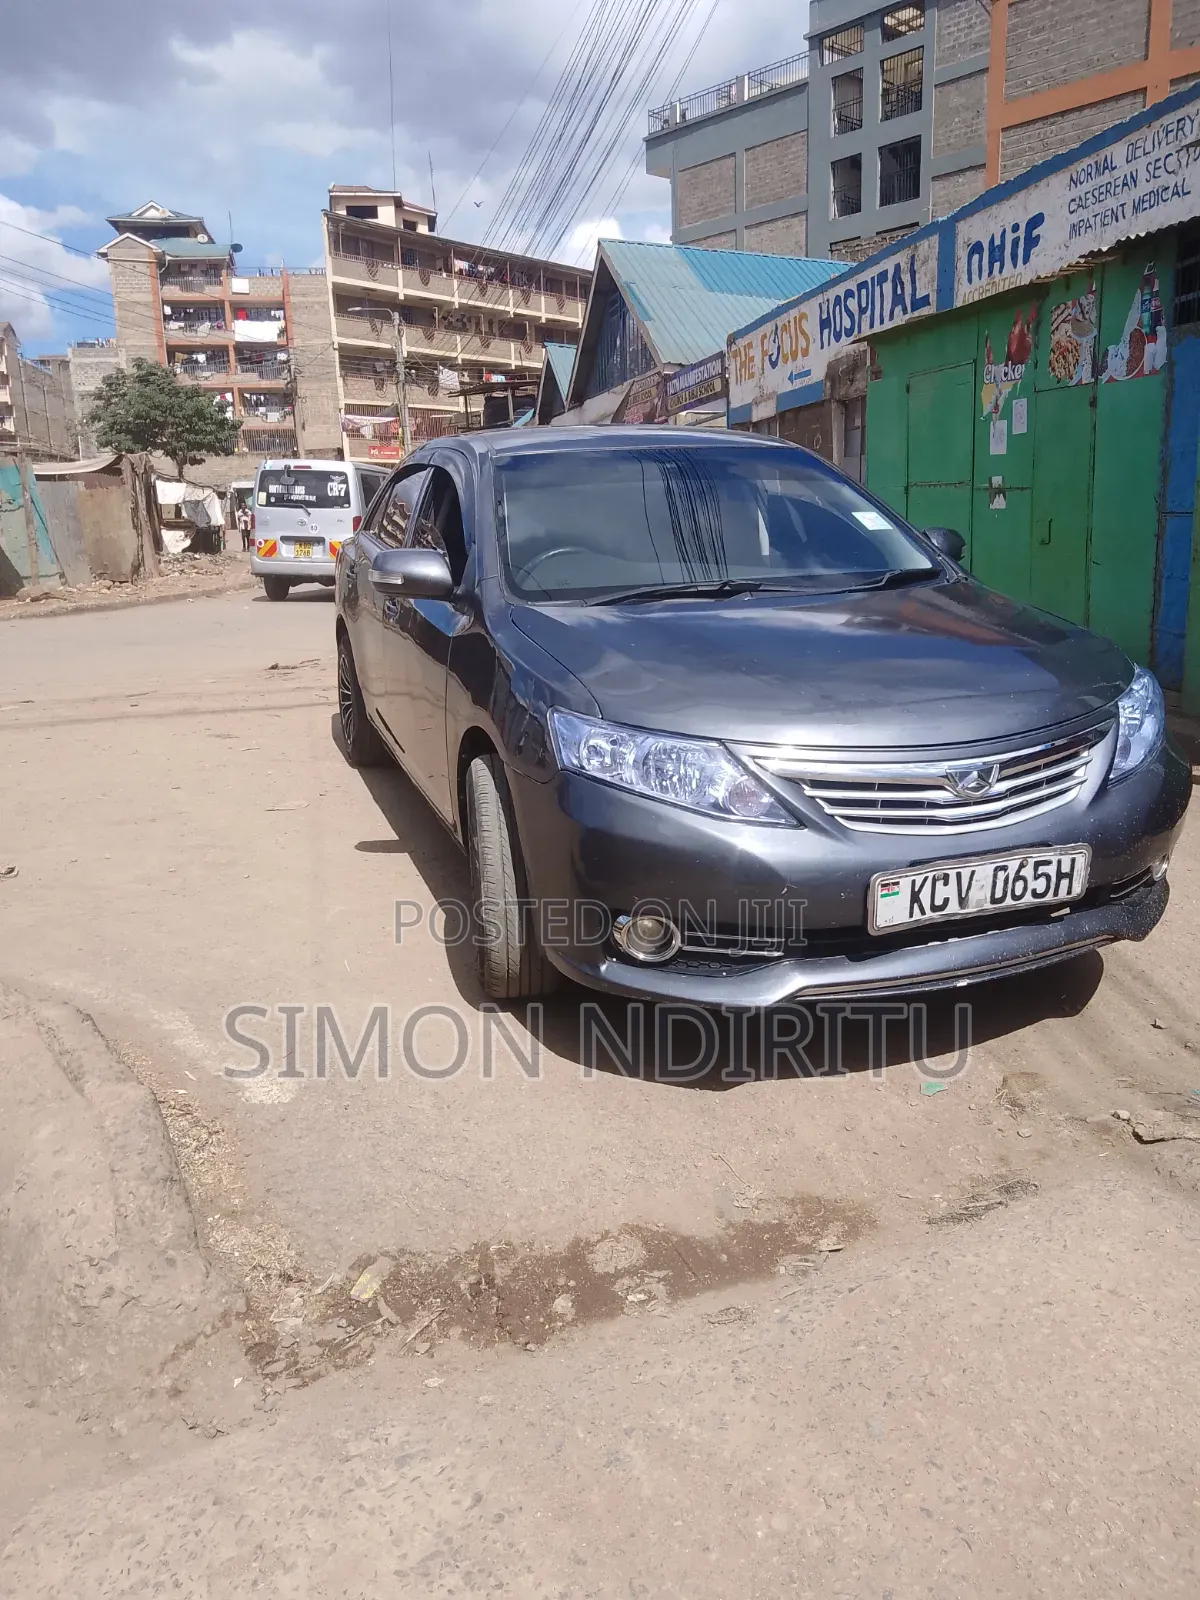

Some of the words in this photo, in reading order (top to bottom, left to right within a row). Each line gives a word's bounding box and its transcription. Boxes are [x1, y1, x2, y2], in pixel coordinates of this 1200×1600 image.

[1069, 152, 1118, 191] NORMAL
[1126, 109, 1199, 164] DELIVERY
[1068, 169, 1138, 214] CAESEREAN
[1069, 203, 1127, 240] INPATIENT
[1132, 178, 1191, 217] MEDICAL
[731, 340, 756, 386] THE
[760, 312, 811, 376] FOCUS
[818, 254, 932, 350] HOSPITAL
[680, 358, 722, 390] MANIFESTATION
[984, 361, 1025, 384] Ccke
[327, 482, 347, 497] CR7
[908, 870, 977, 919] KCV
[989, 856, 1077, 906] 065H
